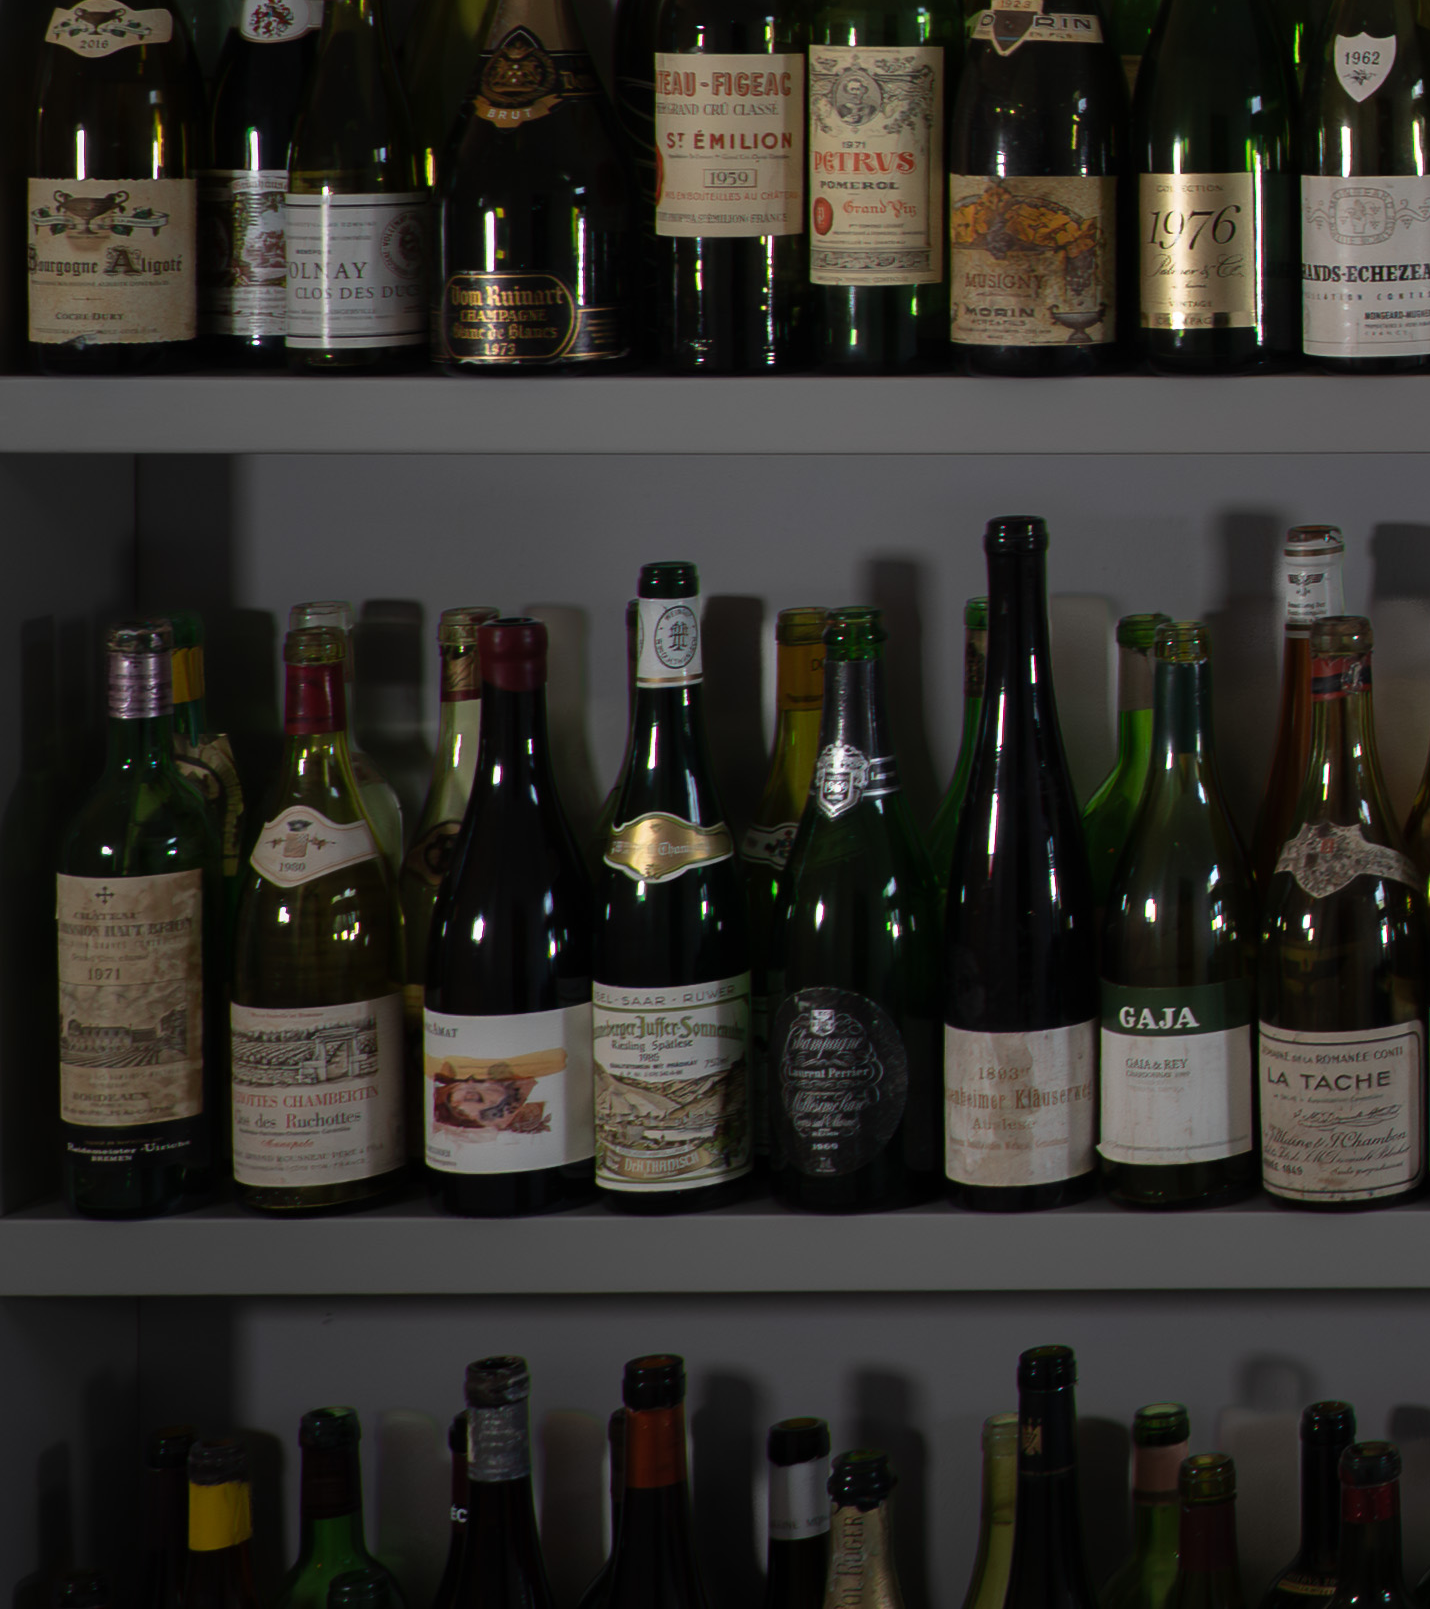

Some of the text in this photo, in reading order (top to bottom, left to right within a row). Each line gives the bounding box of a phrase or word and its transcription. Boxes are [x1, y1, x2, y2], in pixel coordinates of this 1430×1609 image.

[1343, 50, 1380, 66] 1962
[486, 105, 534, 123] BRUT
[813, 151, 915, 174] PETRVS
[708, 170, 749, 185] 1959
[818, 180, 900, 190] POMEROL
[1147, 202, 1240, 249] 1976
[1118, 1006, 1200, 1029] GAJA
[1267, 1066, 1392, 1092] LA TACHE
